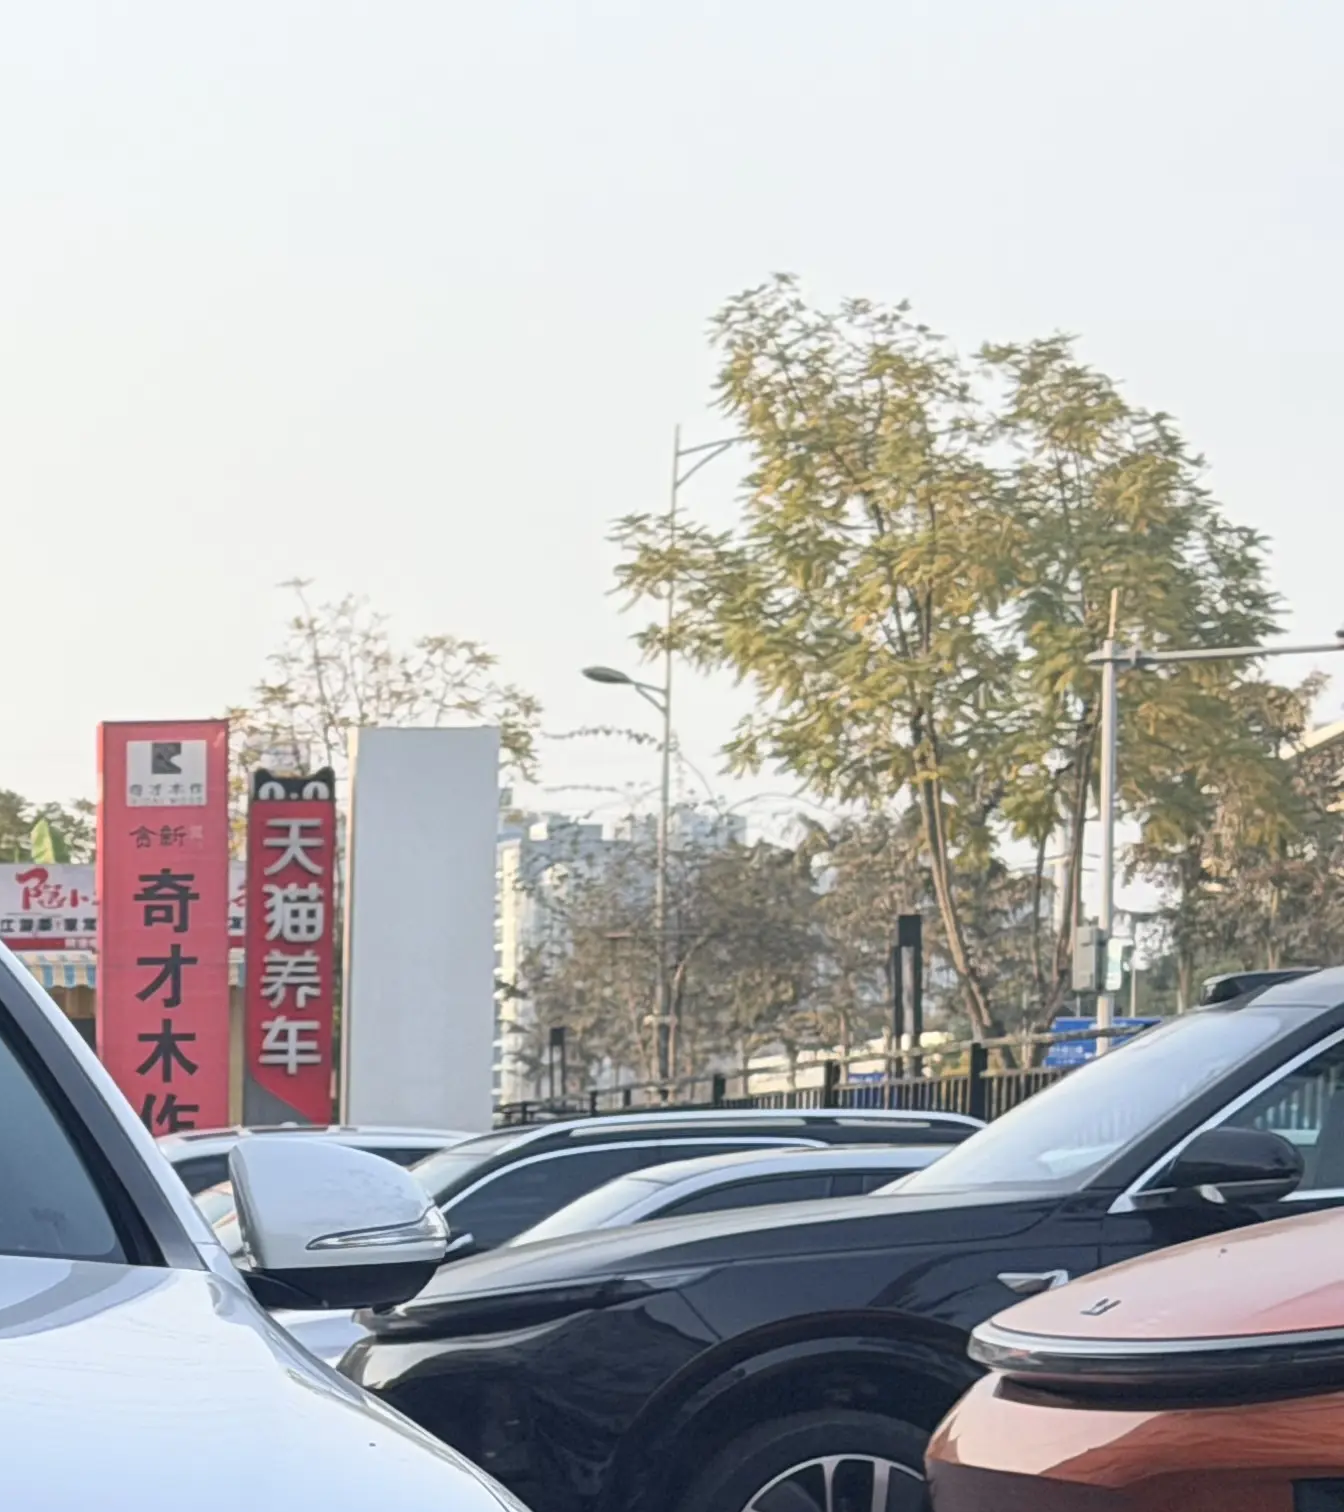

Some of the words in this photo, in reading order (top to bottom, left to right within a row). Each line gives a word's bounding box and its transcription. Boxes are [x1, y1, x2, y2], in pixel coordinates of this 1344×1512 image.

[133, 867, 200, 1132] 奇才木作
[259, 817, 325, 1075] 天猫养车
